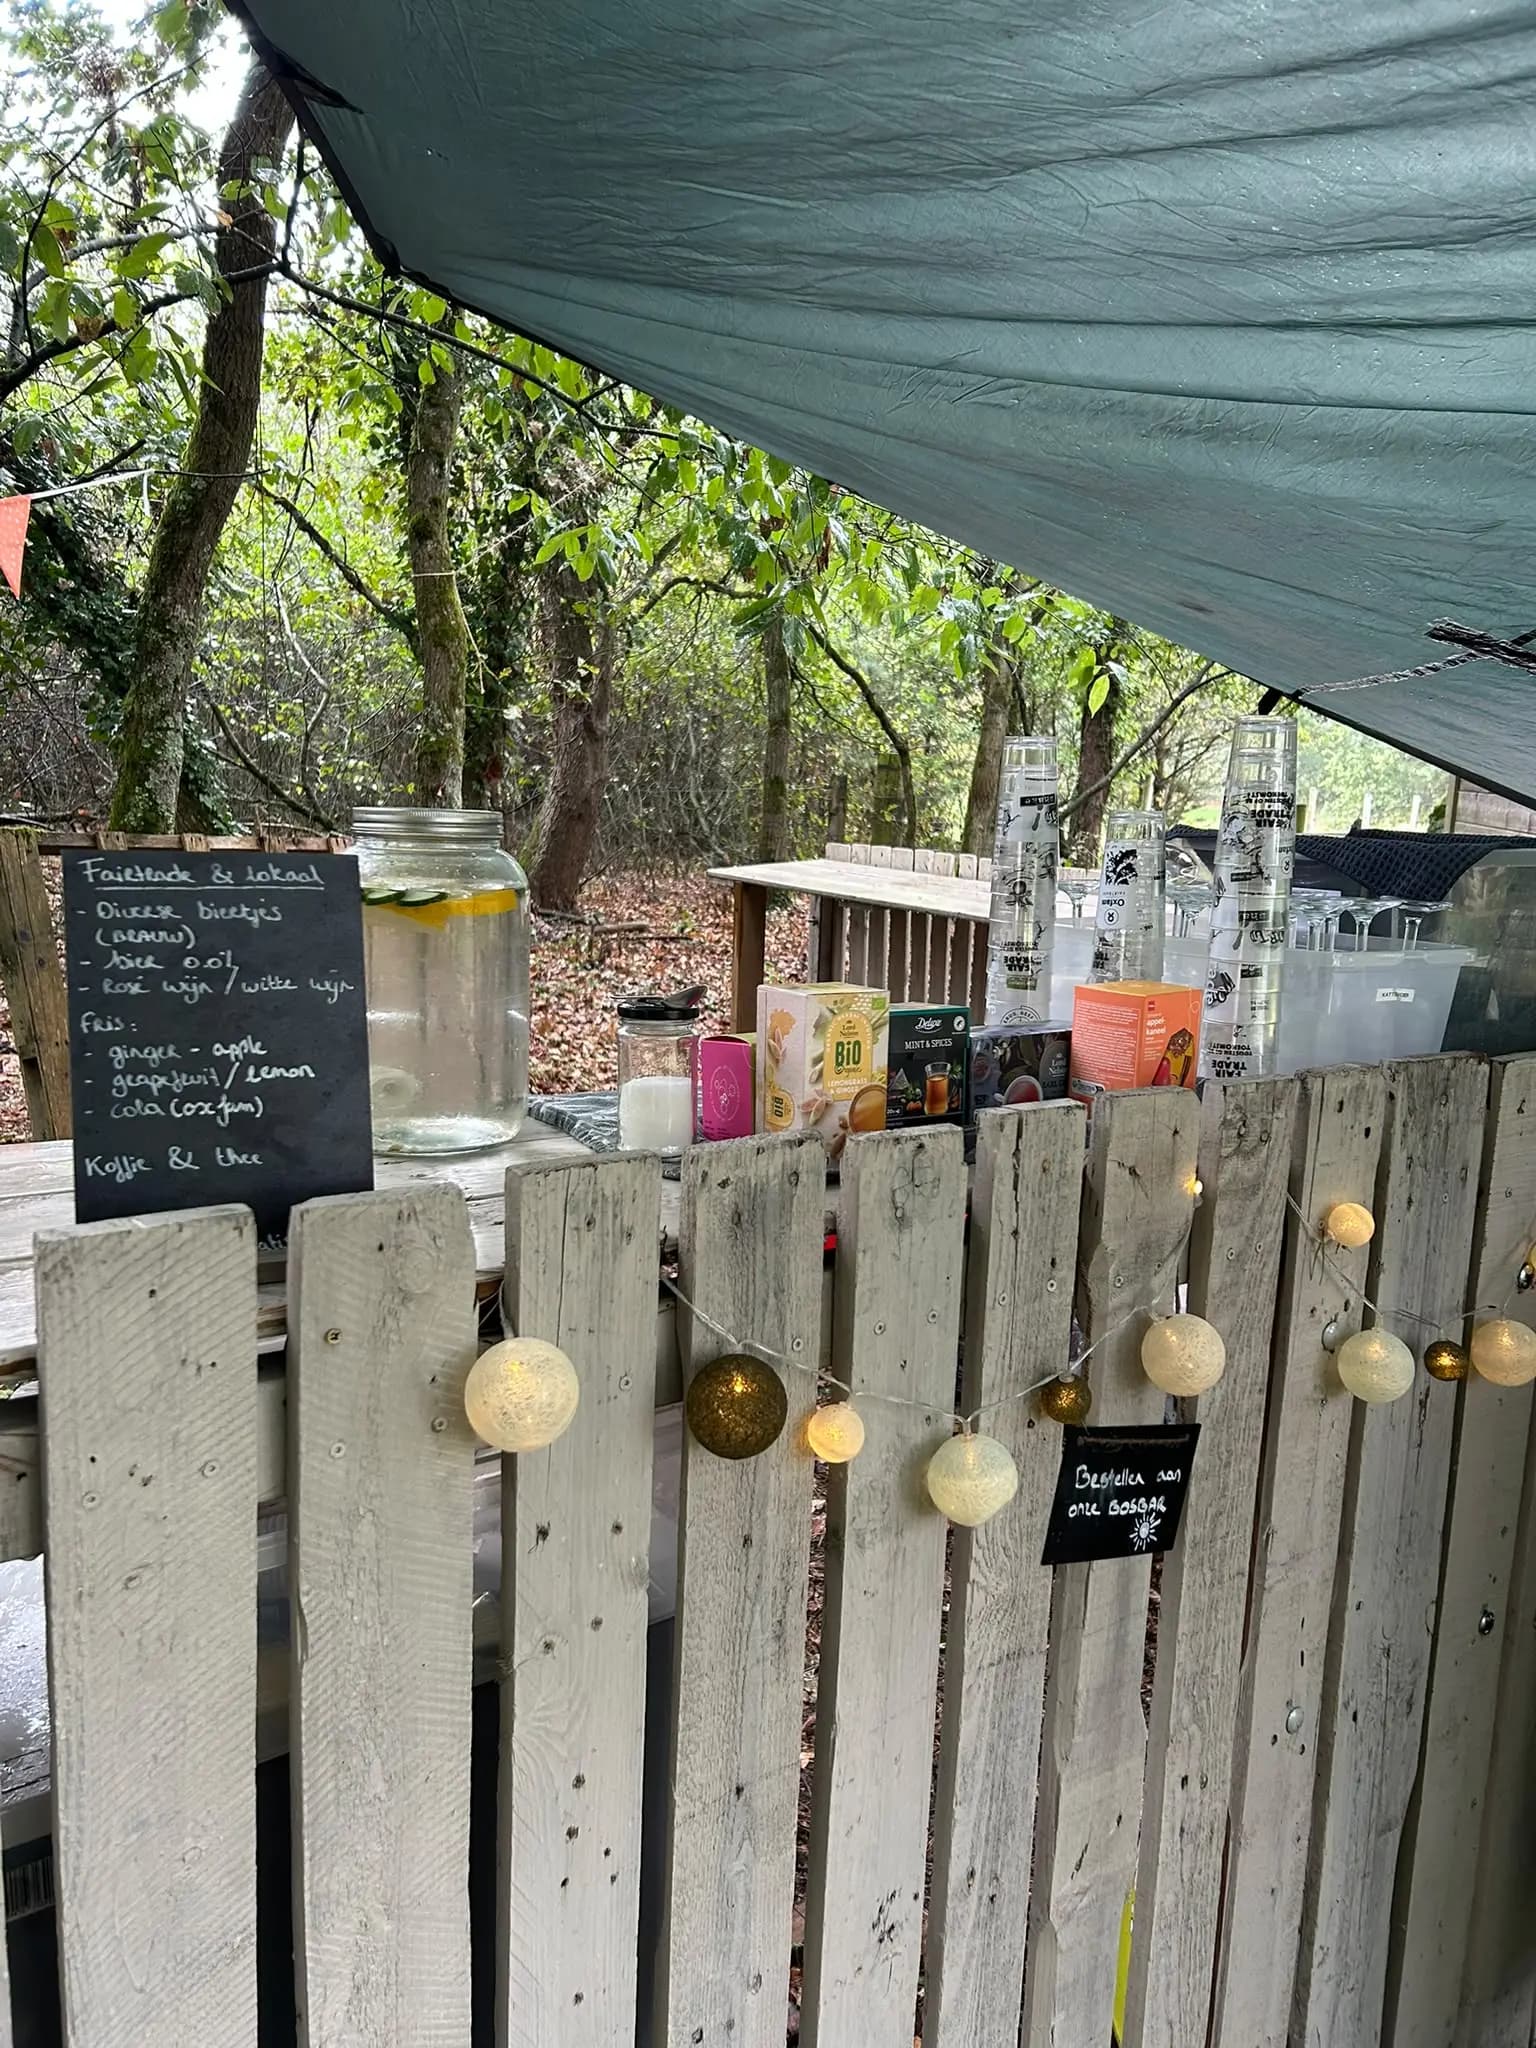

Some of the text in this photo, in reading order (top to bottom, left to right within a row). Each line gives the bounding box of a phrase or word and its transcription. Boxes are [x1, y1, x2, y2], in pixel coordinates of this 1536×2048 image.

[78, 857, 196, 884] Fairtrade
[211, 863, 235, 885] &
[96, 900, 182, 920] Diverse
[197, 897, 283, 928] biertjes
[162, 975, 213, 1004] wijn
[241, 974, 299, 994] witte
[108, 1045, 182, 1069] ginger
[211, 1034, 269, 1064] apple
[905, 1040, 925, 1050] MINT
[932, 1038, 953, 1048] SPICES
[1211, 1060, 1247, 1070] TRADE
[1214, 1069, 1242, 1078] FAIR
[84, 1145, 265, 1184] Koffie & thee
[1075, 1464, 1182, 1489] Bestellen aan
[1068, 1495, 1168, 1518] onze BOSBAR
